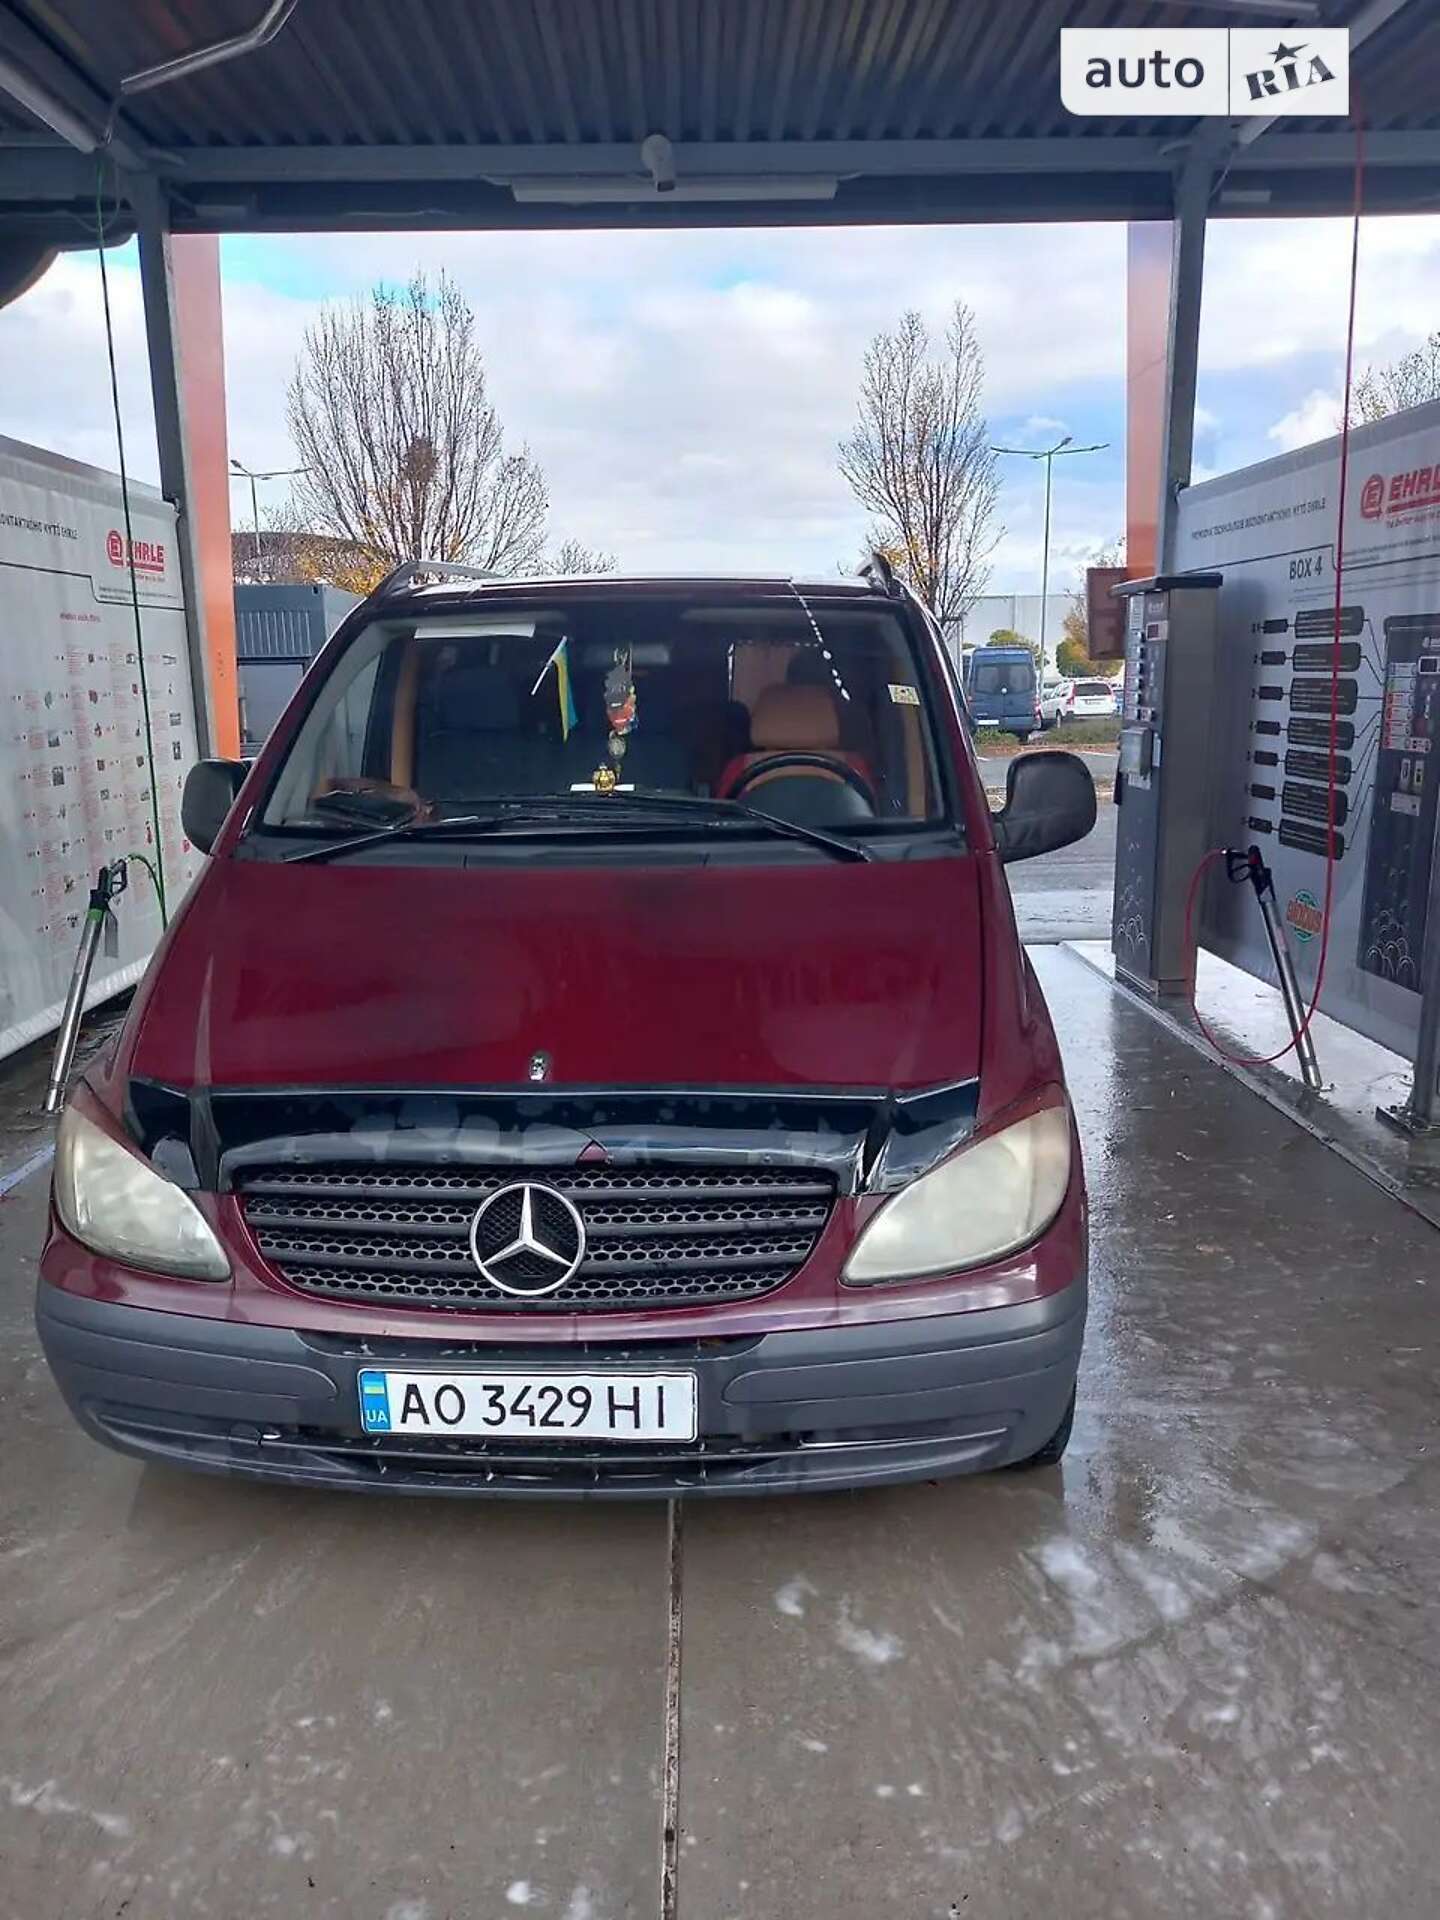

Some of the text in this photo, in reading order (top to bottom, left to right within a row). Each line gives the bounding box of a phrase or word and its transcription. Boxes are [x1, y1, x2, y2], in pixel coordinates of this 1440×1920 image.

[1289, 555, 1323, 580] BOX 4
[366, 1411, 388, 1424] UA
[400, 1384, 665, 1429] AO 3429 HI
